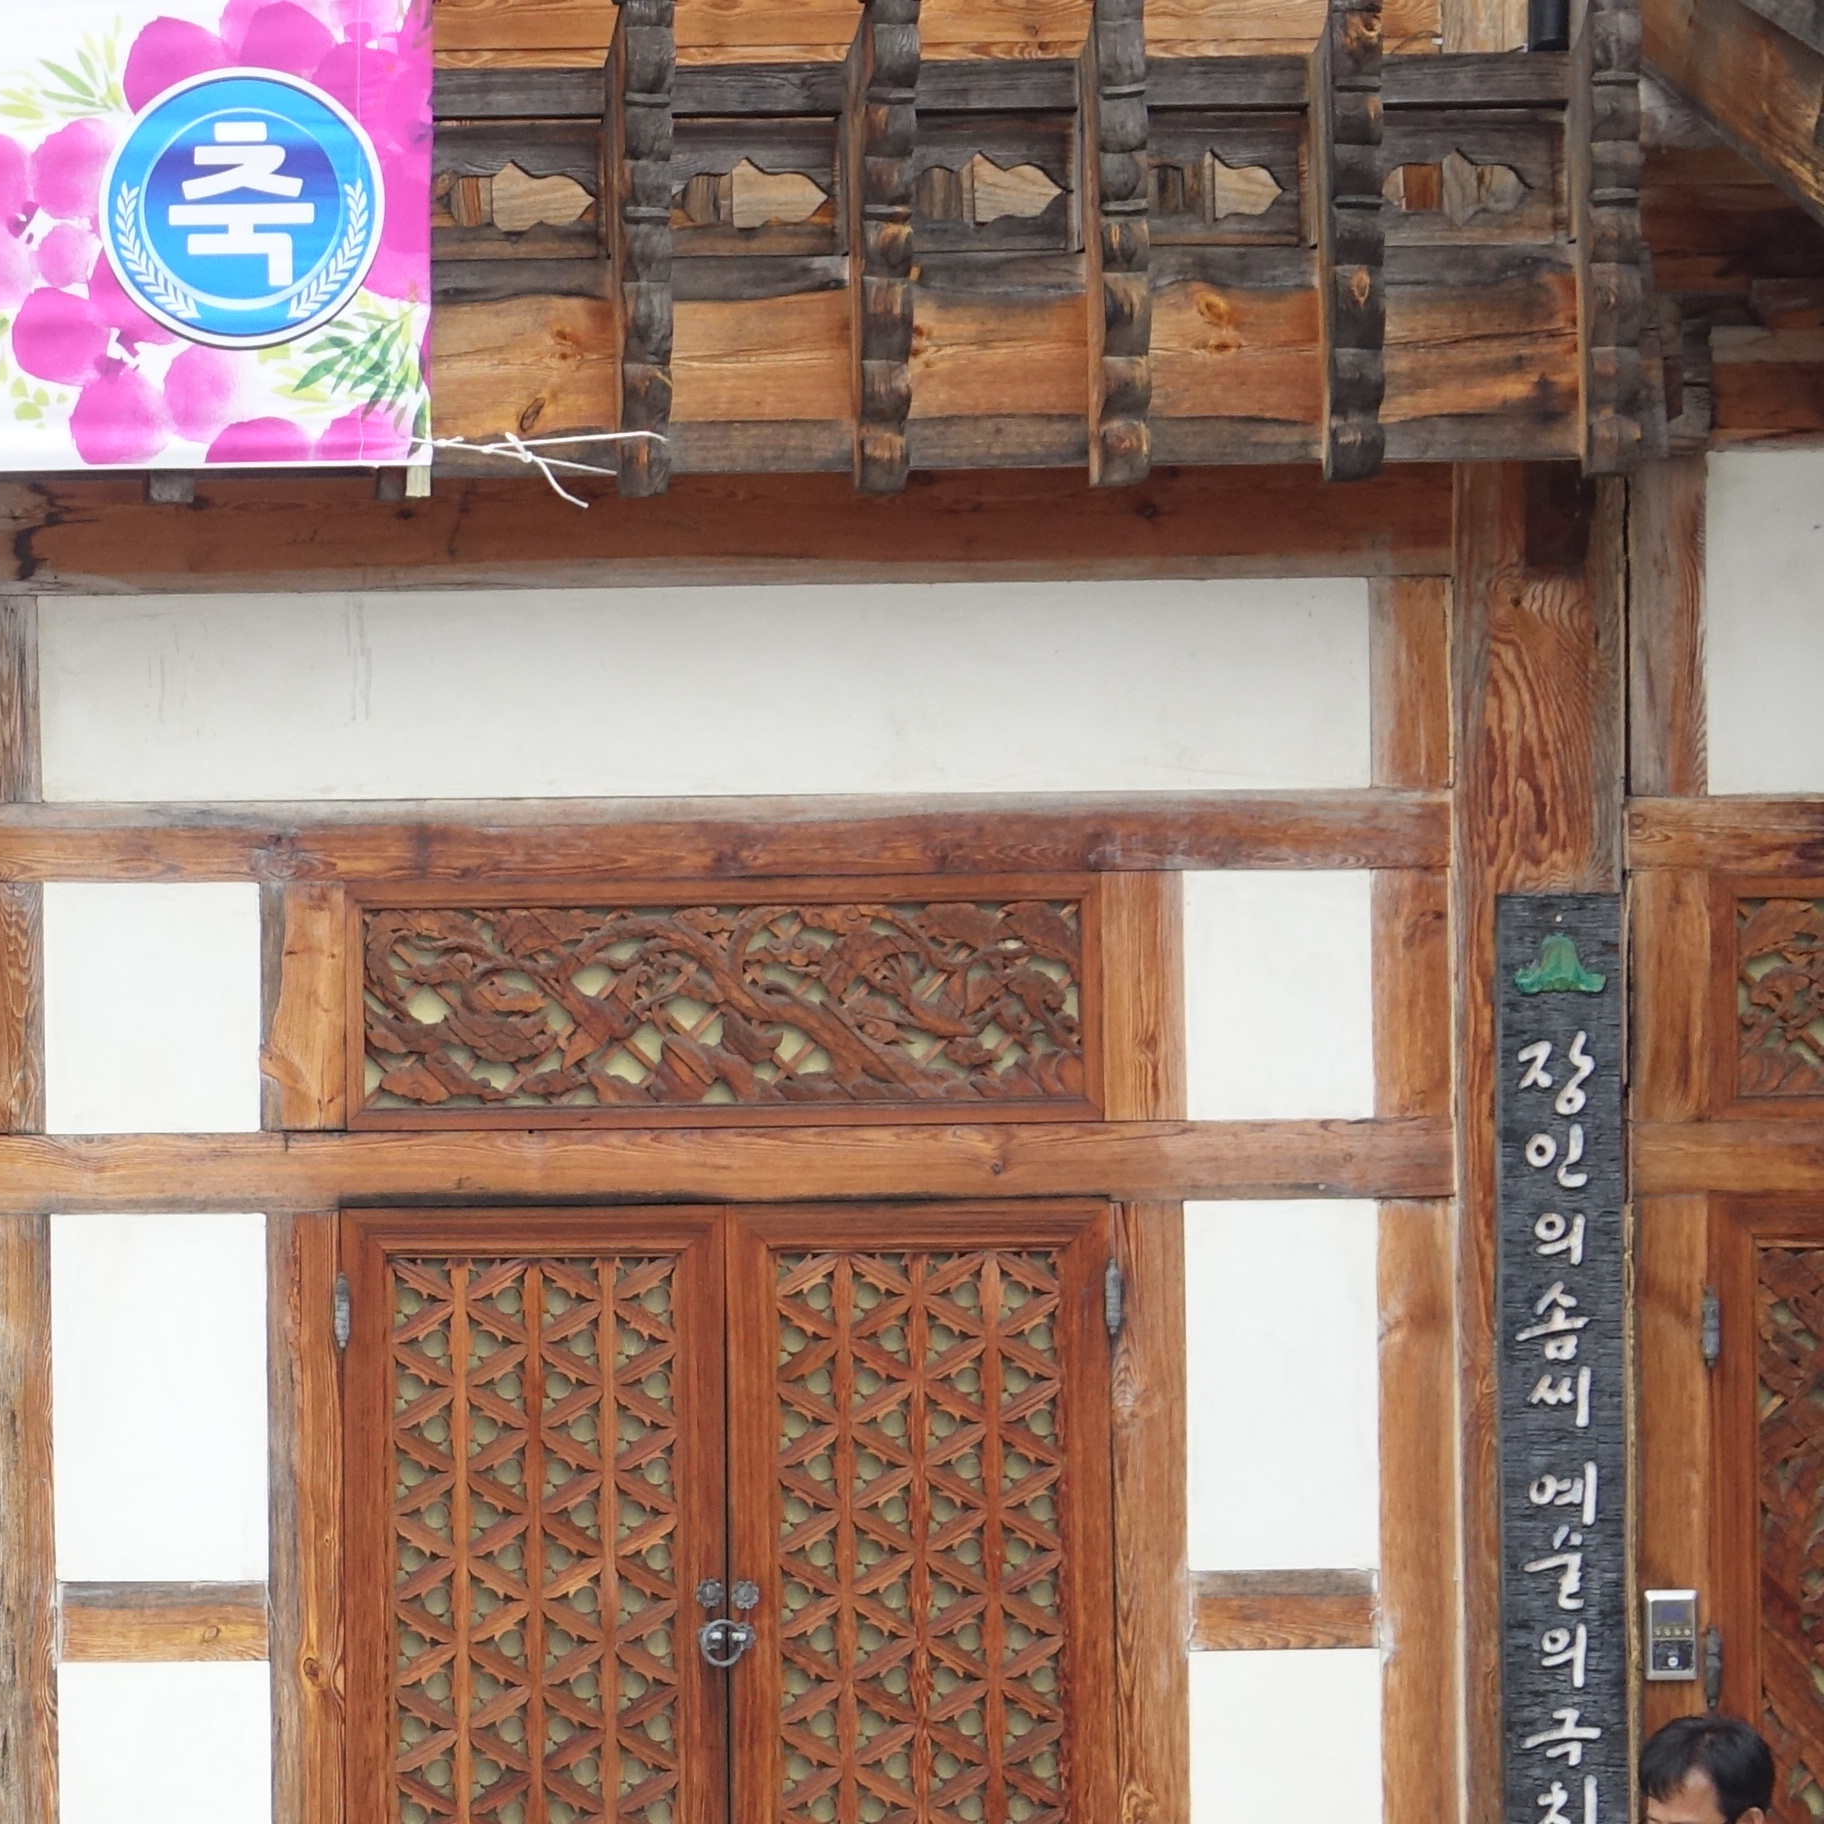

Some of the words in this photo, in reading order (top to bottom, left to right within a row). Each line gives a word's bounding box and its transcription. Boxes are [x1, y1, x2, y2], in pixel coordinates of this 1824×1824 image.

[167, 121, 315, 287] 축
[1517, 1031, 1596, 1266] 장인의
[1514, 1281, 1592, 1429] 솜씨
[1523, 1461, 1598, 1688] 예술의
